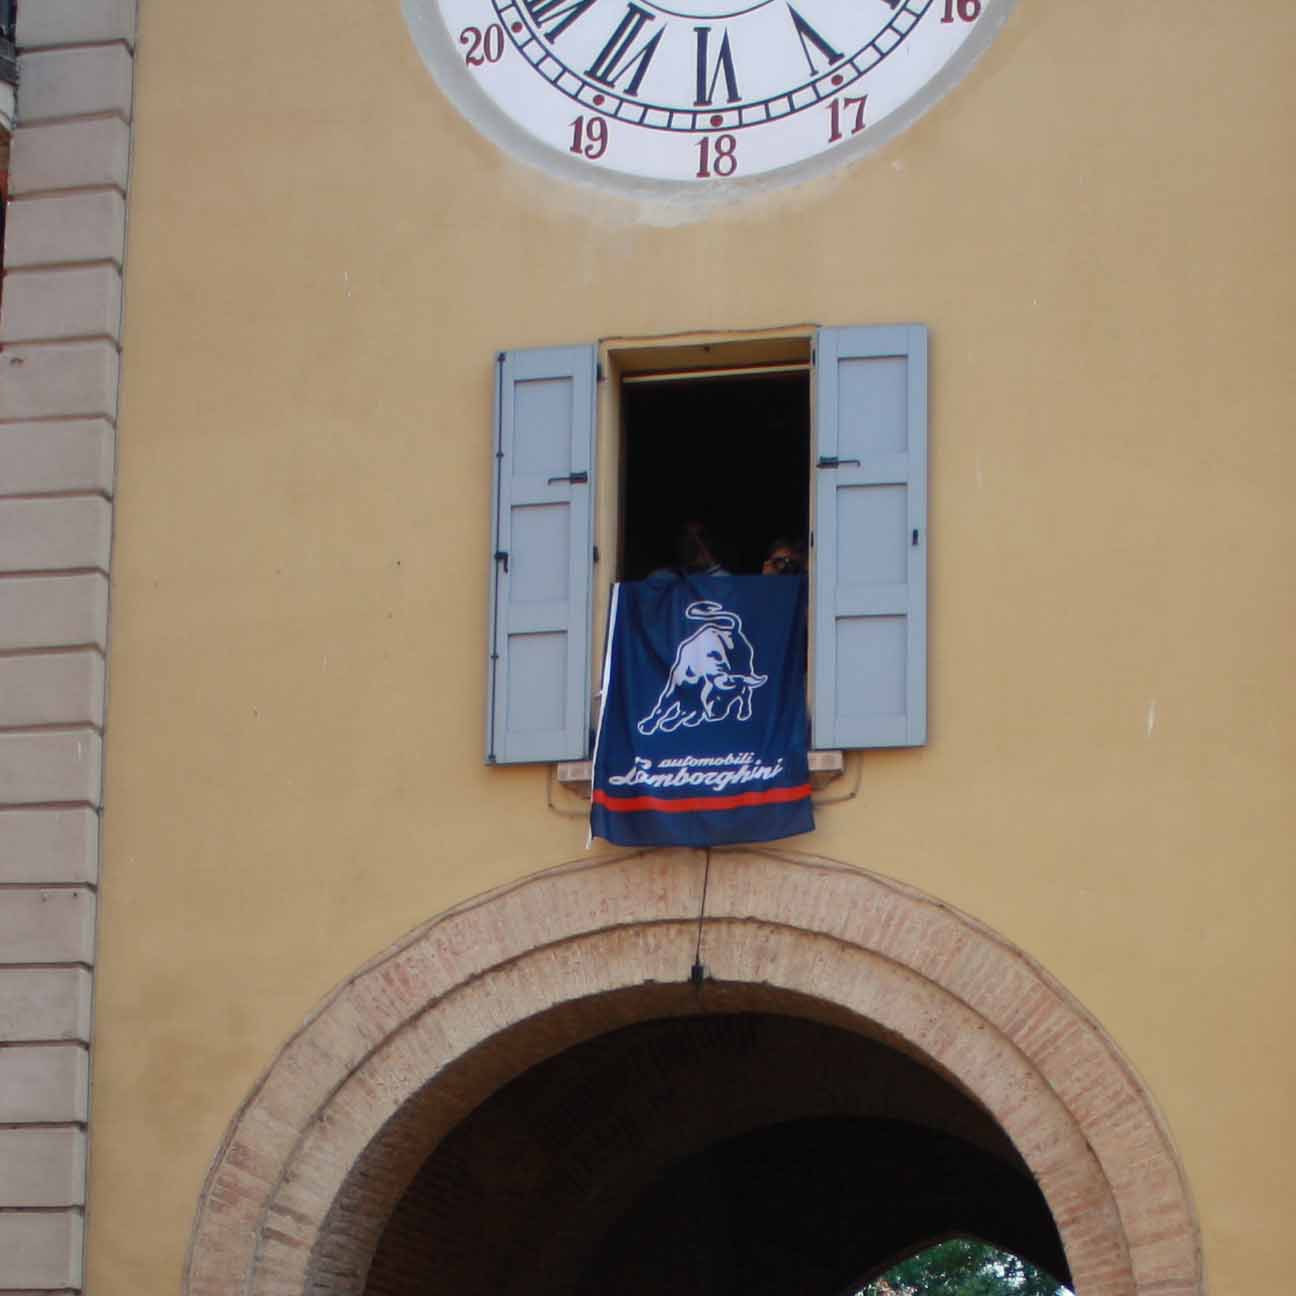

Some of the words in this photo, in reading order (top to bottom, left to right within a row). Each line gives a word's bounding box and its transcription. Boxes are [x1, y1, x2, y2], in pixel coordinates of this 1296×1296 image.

[460, 23, 505, 67] 20
[568, 115, 609, 160] 19
[824, 93, 869, 144] 17
[695, 133, 738, 179] 18
[608, 756, 784, 792] Lamborghini
[657, 751, 755, 768] automobili
